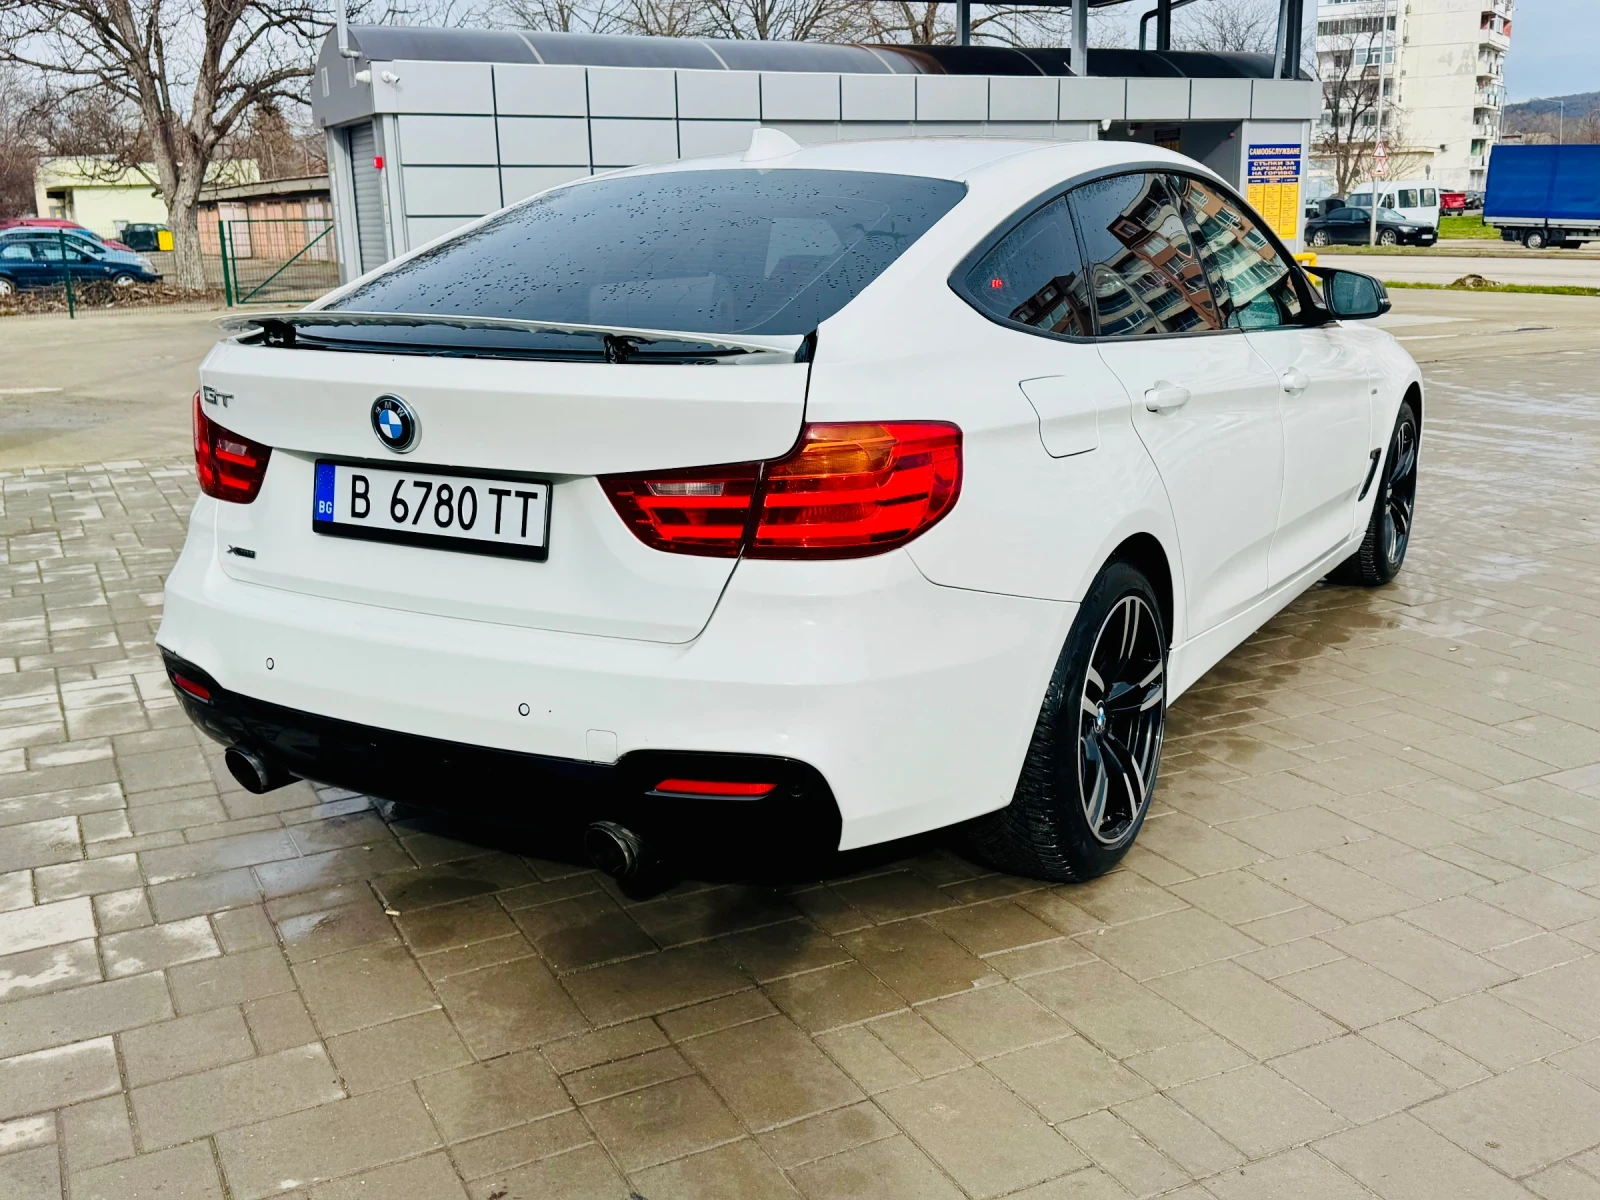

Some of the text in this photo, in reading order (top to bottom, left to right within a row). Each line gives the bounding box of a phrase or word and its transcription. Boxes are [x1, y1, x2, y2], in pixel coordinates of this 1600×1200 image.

[203, 386, 234, 408] GT
[375, 400, 406, 418] BMW
[318, 500, 332, 514] BG
[350, 474, 538, 538] B 6780 TT
